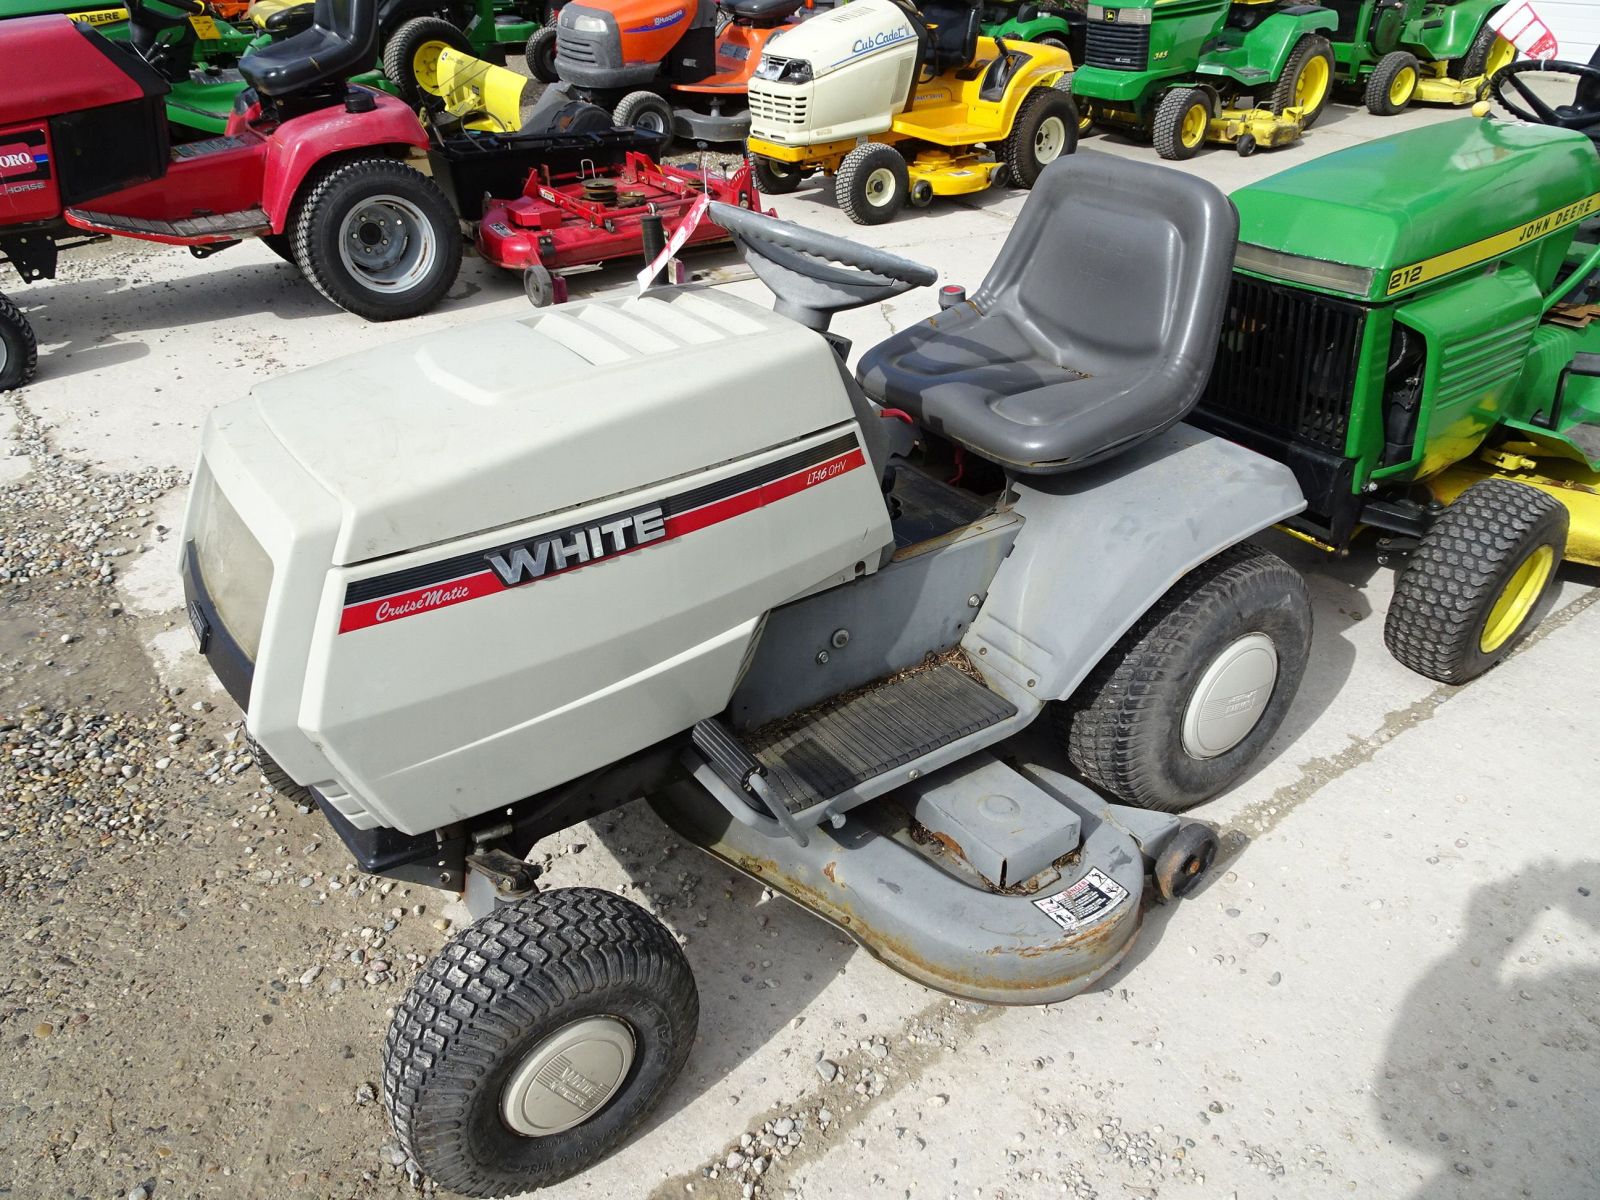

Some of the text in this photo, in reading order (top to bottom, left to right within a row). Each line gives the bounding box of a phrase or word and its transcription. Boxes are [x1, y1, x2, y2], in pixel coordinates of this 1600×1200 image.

[79, 12, 120, 23] DEERE
[853, 28, 905, 53] Cub Cadet
[1519, 199, 1593, 241] JOHN DEERE
[1389, 265, 1423, 290] 212
[828, 459, 847, 476] OHV
[485, 506, 667, 587] WHITE
